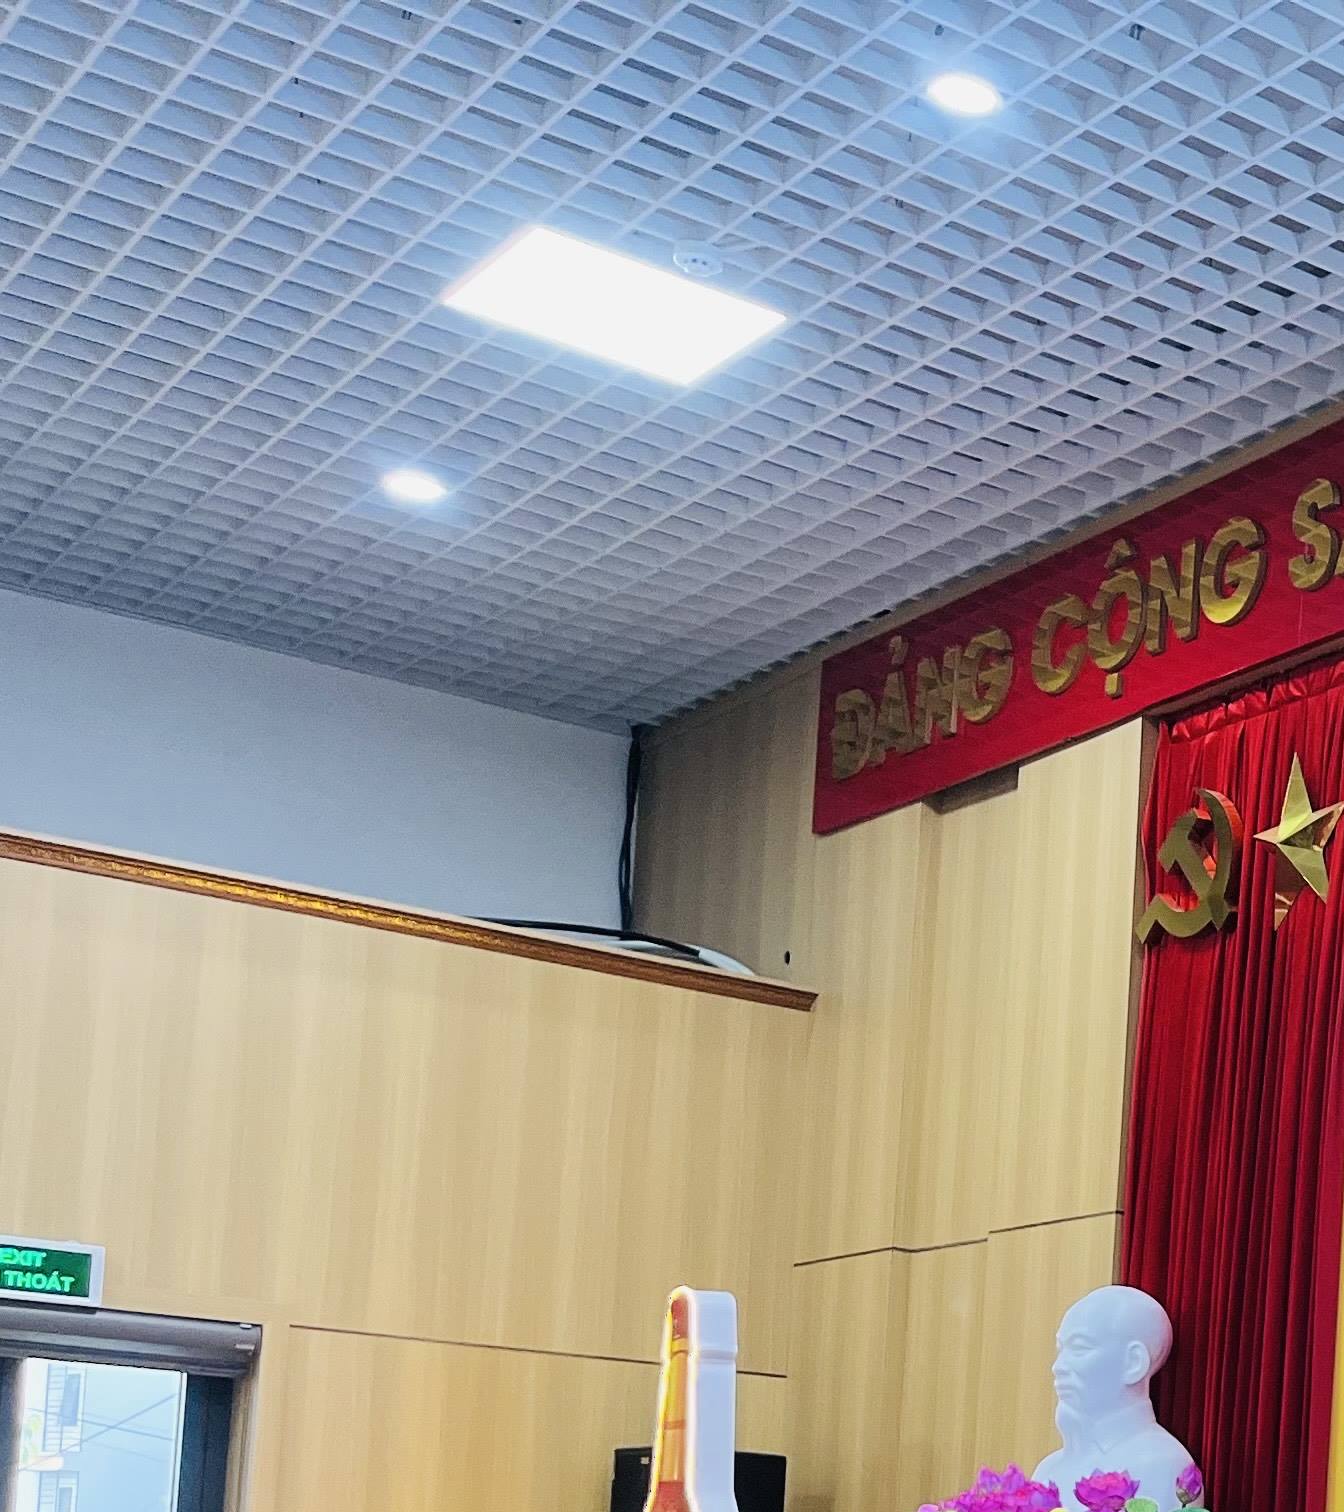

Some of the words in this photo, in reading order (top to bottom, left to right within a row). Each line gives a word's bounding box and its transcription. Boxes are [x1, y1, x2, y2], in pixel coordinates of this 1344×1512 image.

[831, 627, 1014, 780] ĐẢNG
[1031, 516, 1266, 697] CỘNG
[0, 1248, 47, 1267] EXIT
[4, 1270, 76, 1292] THOÁT
